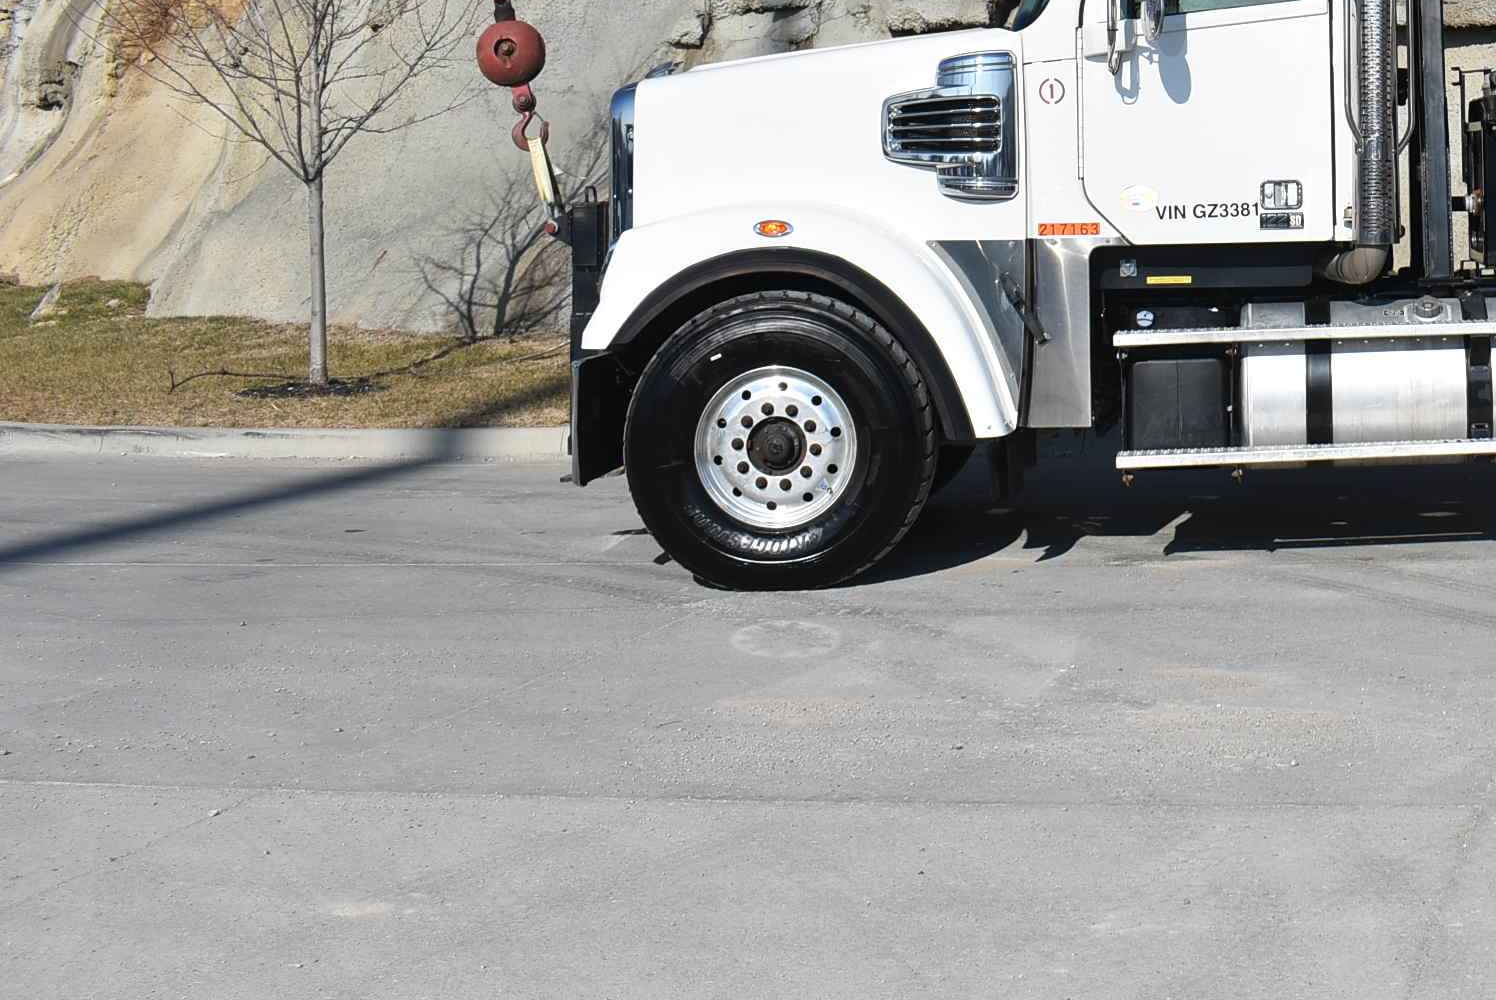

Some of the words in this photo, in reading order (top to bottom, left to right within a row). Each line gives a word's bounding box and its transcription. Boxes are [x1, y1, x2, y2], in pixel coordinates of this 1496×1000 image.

[1155, 204, 1186, 220] VIN
[1192, 202, 1260, 219] GZ3381
[1039, 223, 1100, 236] 217163
